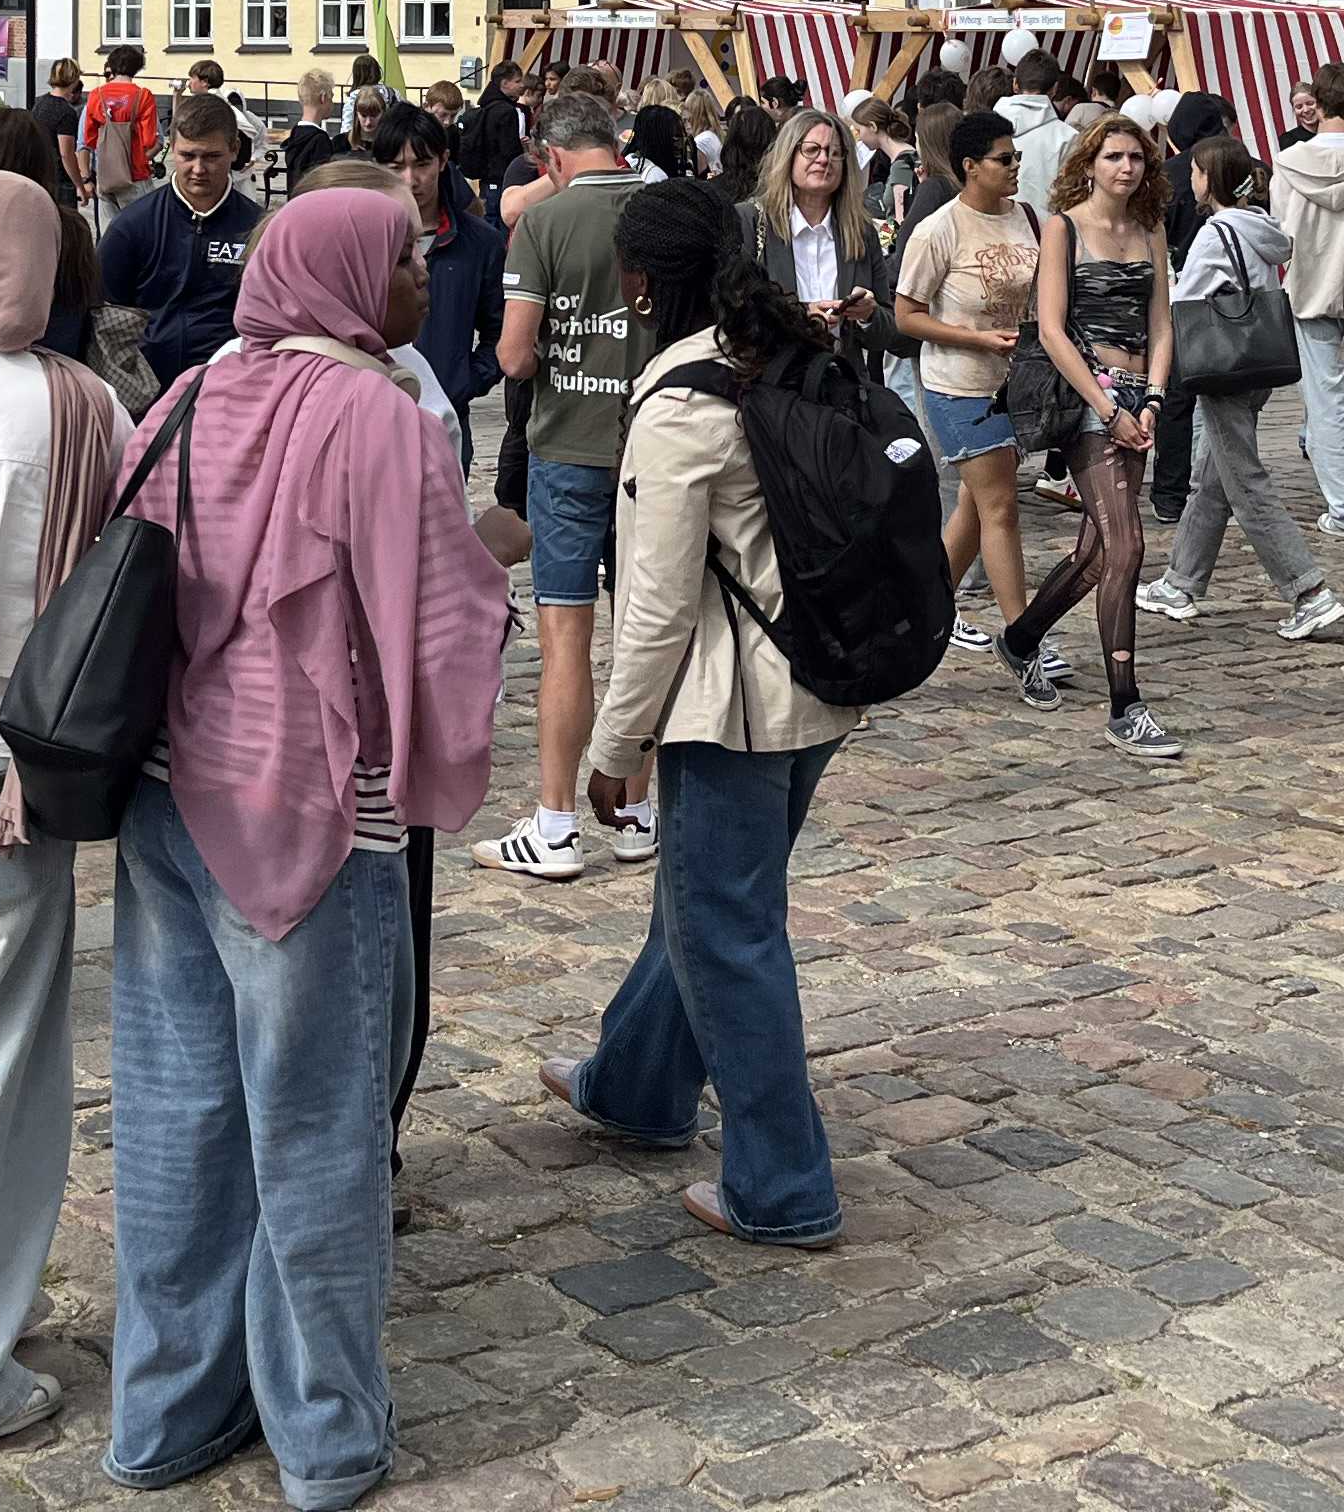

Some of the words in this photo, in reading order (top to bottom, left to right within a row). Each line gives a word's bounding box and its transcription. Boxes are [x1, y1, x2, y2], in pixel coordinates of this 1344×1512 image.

[959, 15, 982, 25] Nyborg
[207, 241, 246, 260] EA7
[549, 291, 580, 311] For
[548, 313, 628, 339] Printing
[549, 365, 629, 396] Equipme
